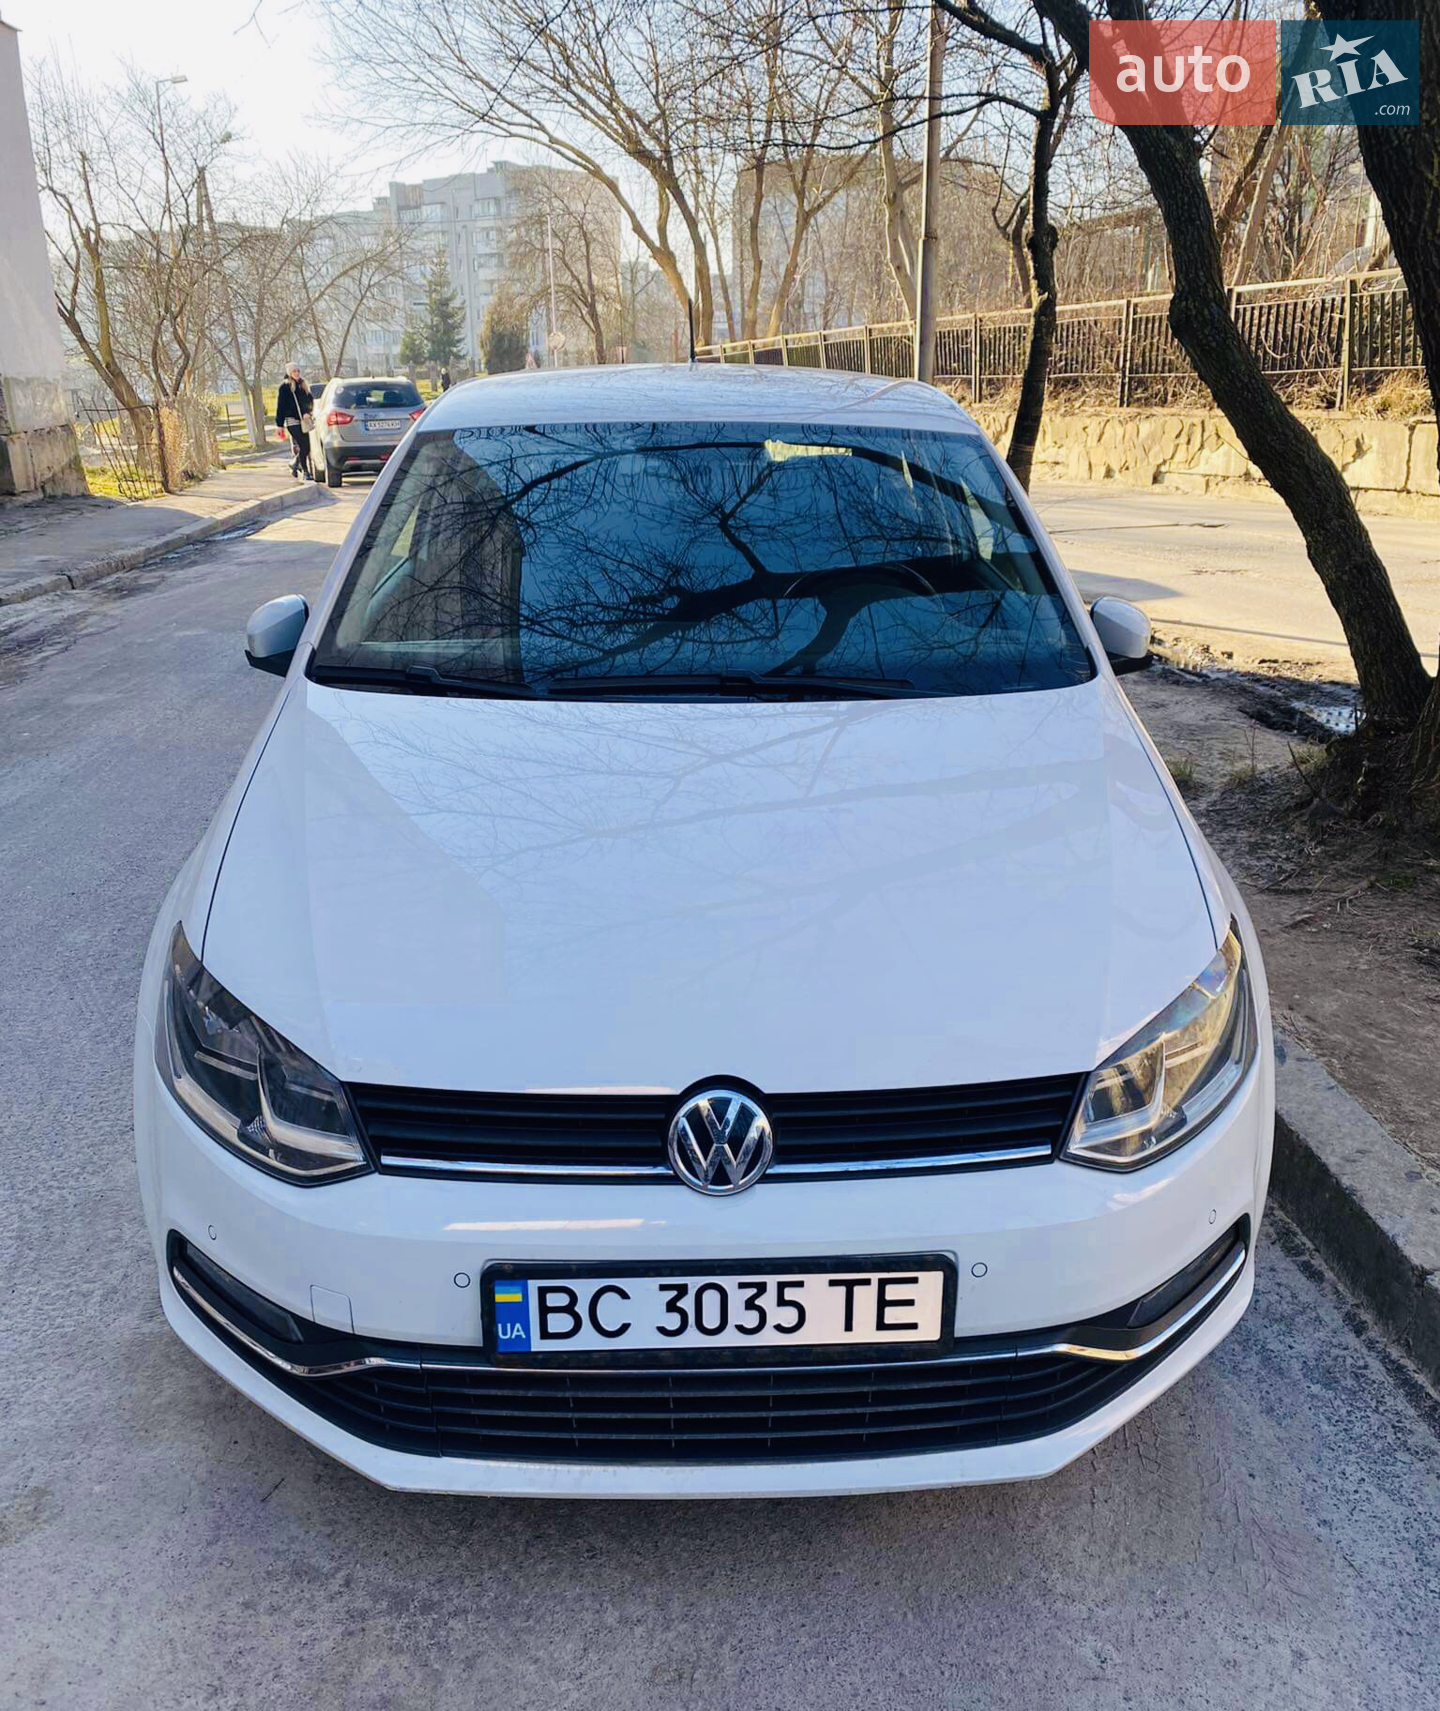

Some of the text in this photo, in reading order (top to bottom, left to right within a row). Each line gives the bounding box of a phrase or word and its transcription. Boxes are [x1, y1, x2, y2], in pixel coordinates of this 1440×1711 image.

[537, 1276, 919, 1340] BC 3035 TE
[497, 1323, 526, 1340] UA
